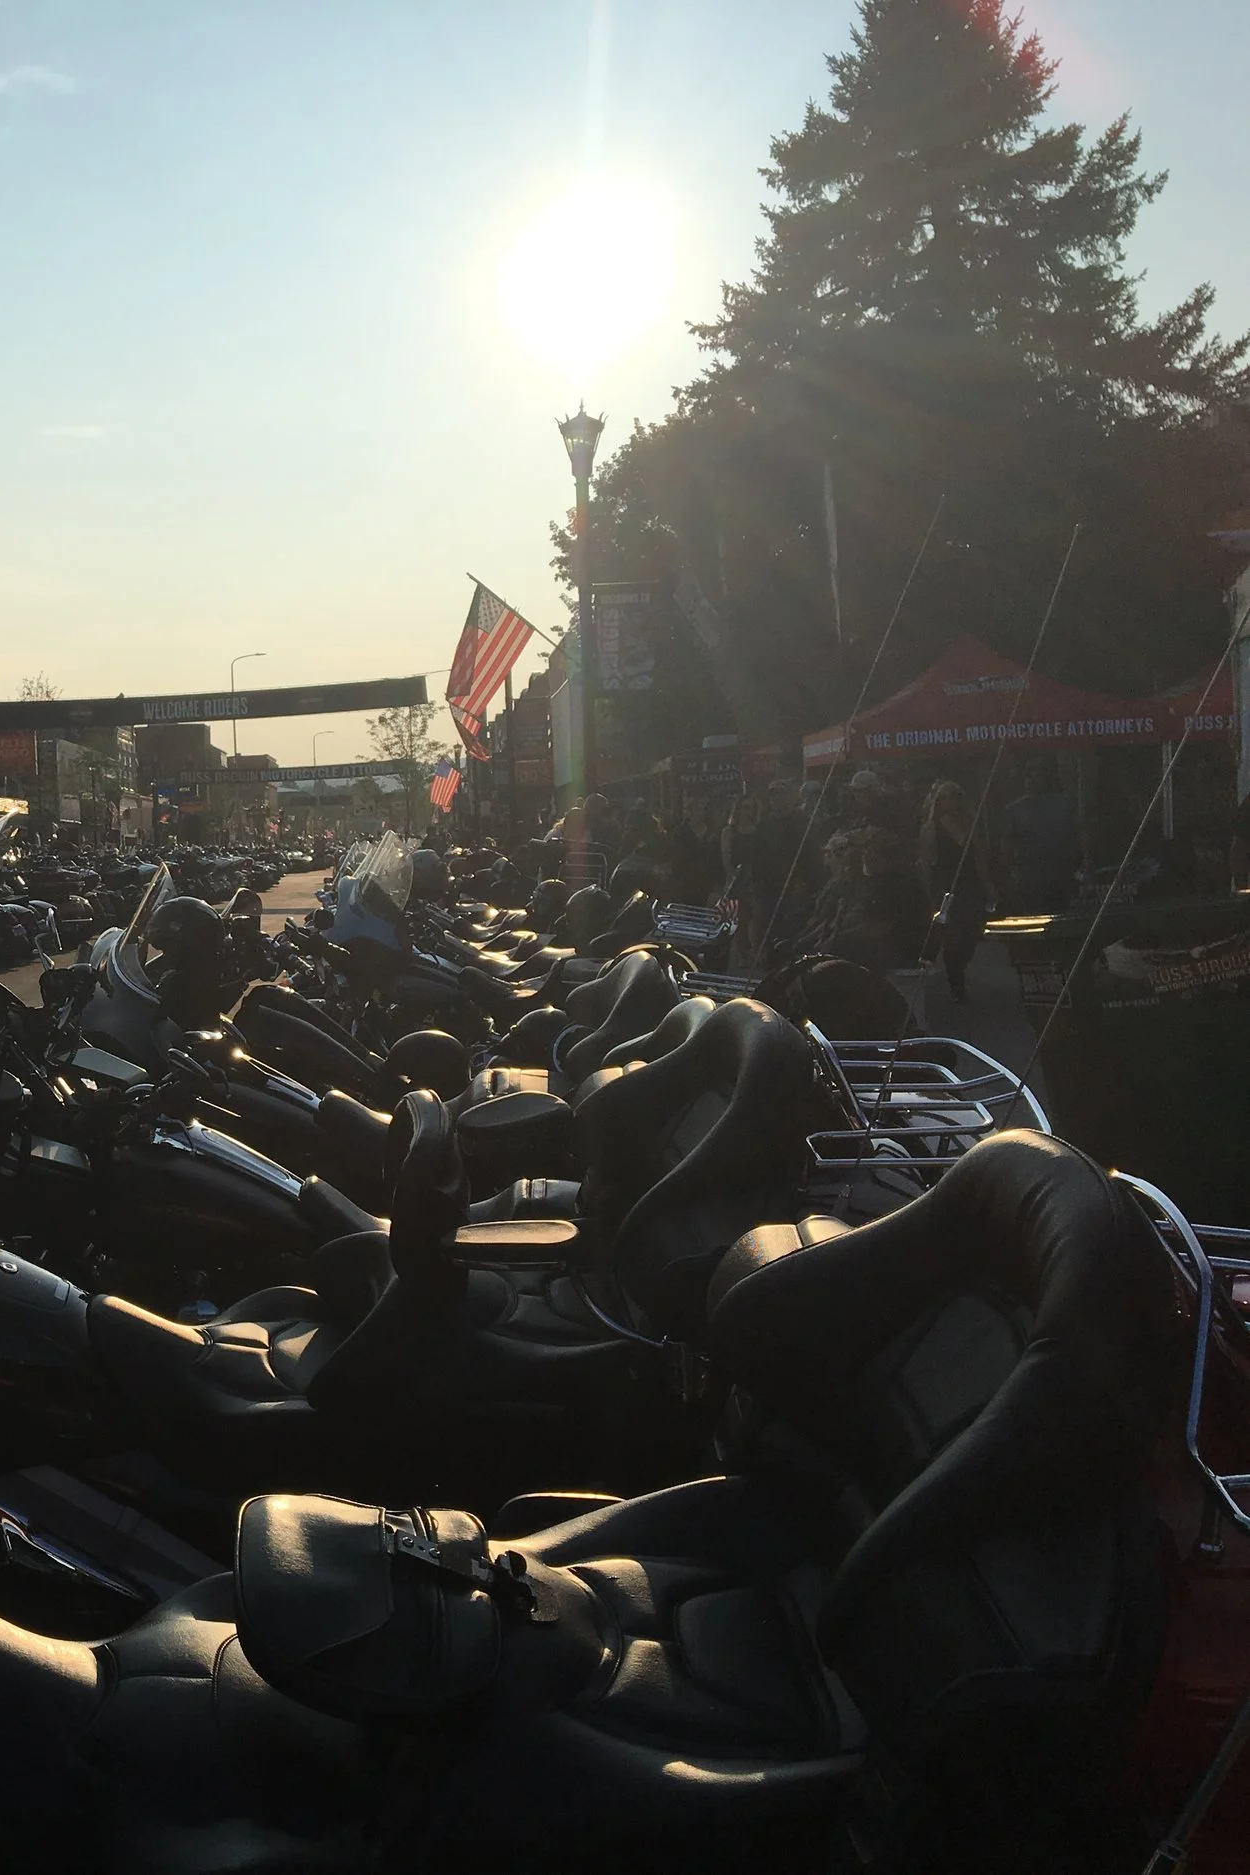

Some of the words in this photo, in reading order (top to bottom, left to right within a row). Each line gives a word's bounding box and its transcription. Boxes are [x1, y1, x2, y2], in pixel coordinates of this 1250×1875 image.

[142, 702, 200, 720] WELCOME
[203, 696, 249, 717] RIDERS
[864, 732, 892, 750] THE
[895, 728, 962, 747] ORIGINAL
[966, 721, 1063, 743] MOTORCYCLE
[1067, 717, 1155, 737] ATTORNEYS
[179, 770, 212, 784] RUSS
[214, 769, 259, 784] BROWN
[260, 766, 339, 782] MOTORCYCLE
